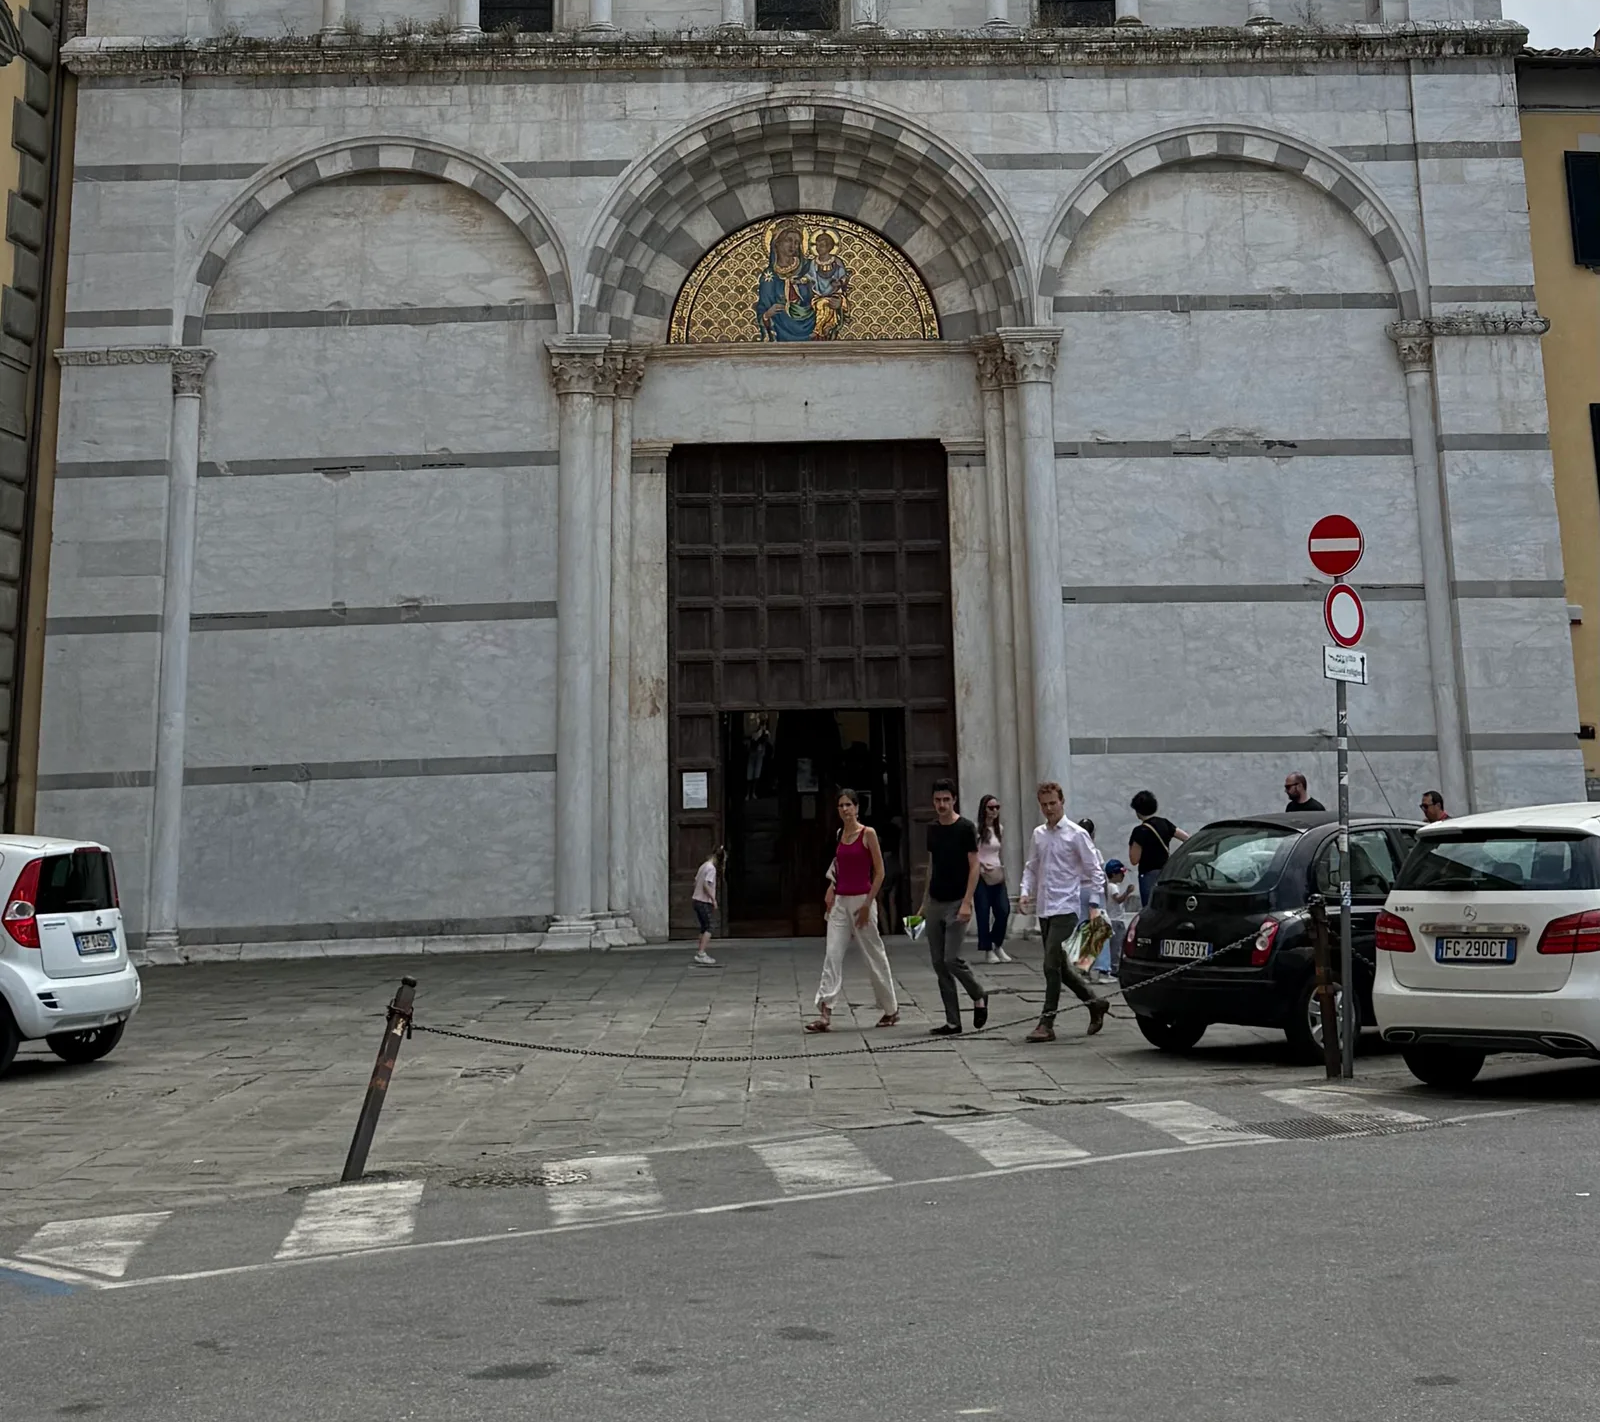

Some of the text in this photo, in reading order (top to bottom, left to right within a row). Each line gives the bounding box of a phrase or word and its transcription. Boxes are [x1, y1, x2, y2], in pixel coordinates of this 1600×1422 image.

[1164, 940, 1176, 955] DY
[1179, 941, 1208, 958] 083XX
[1445, 940, 1506, 958] FG 290CT
